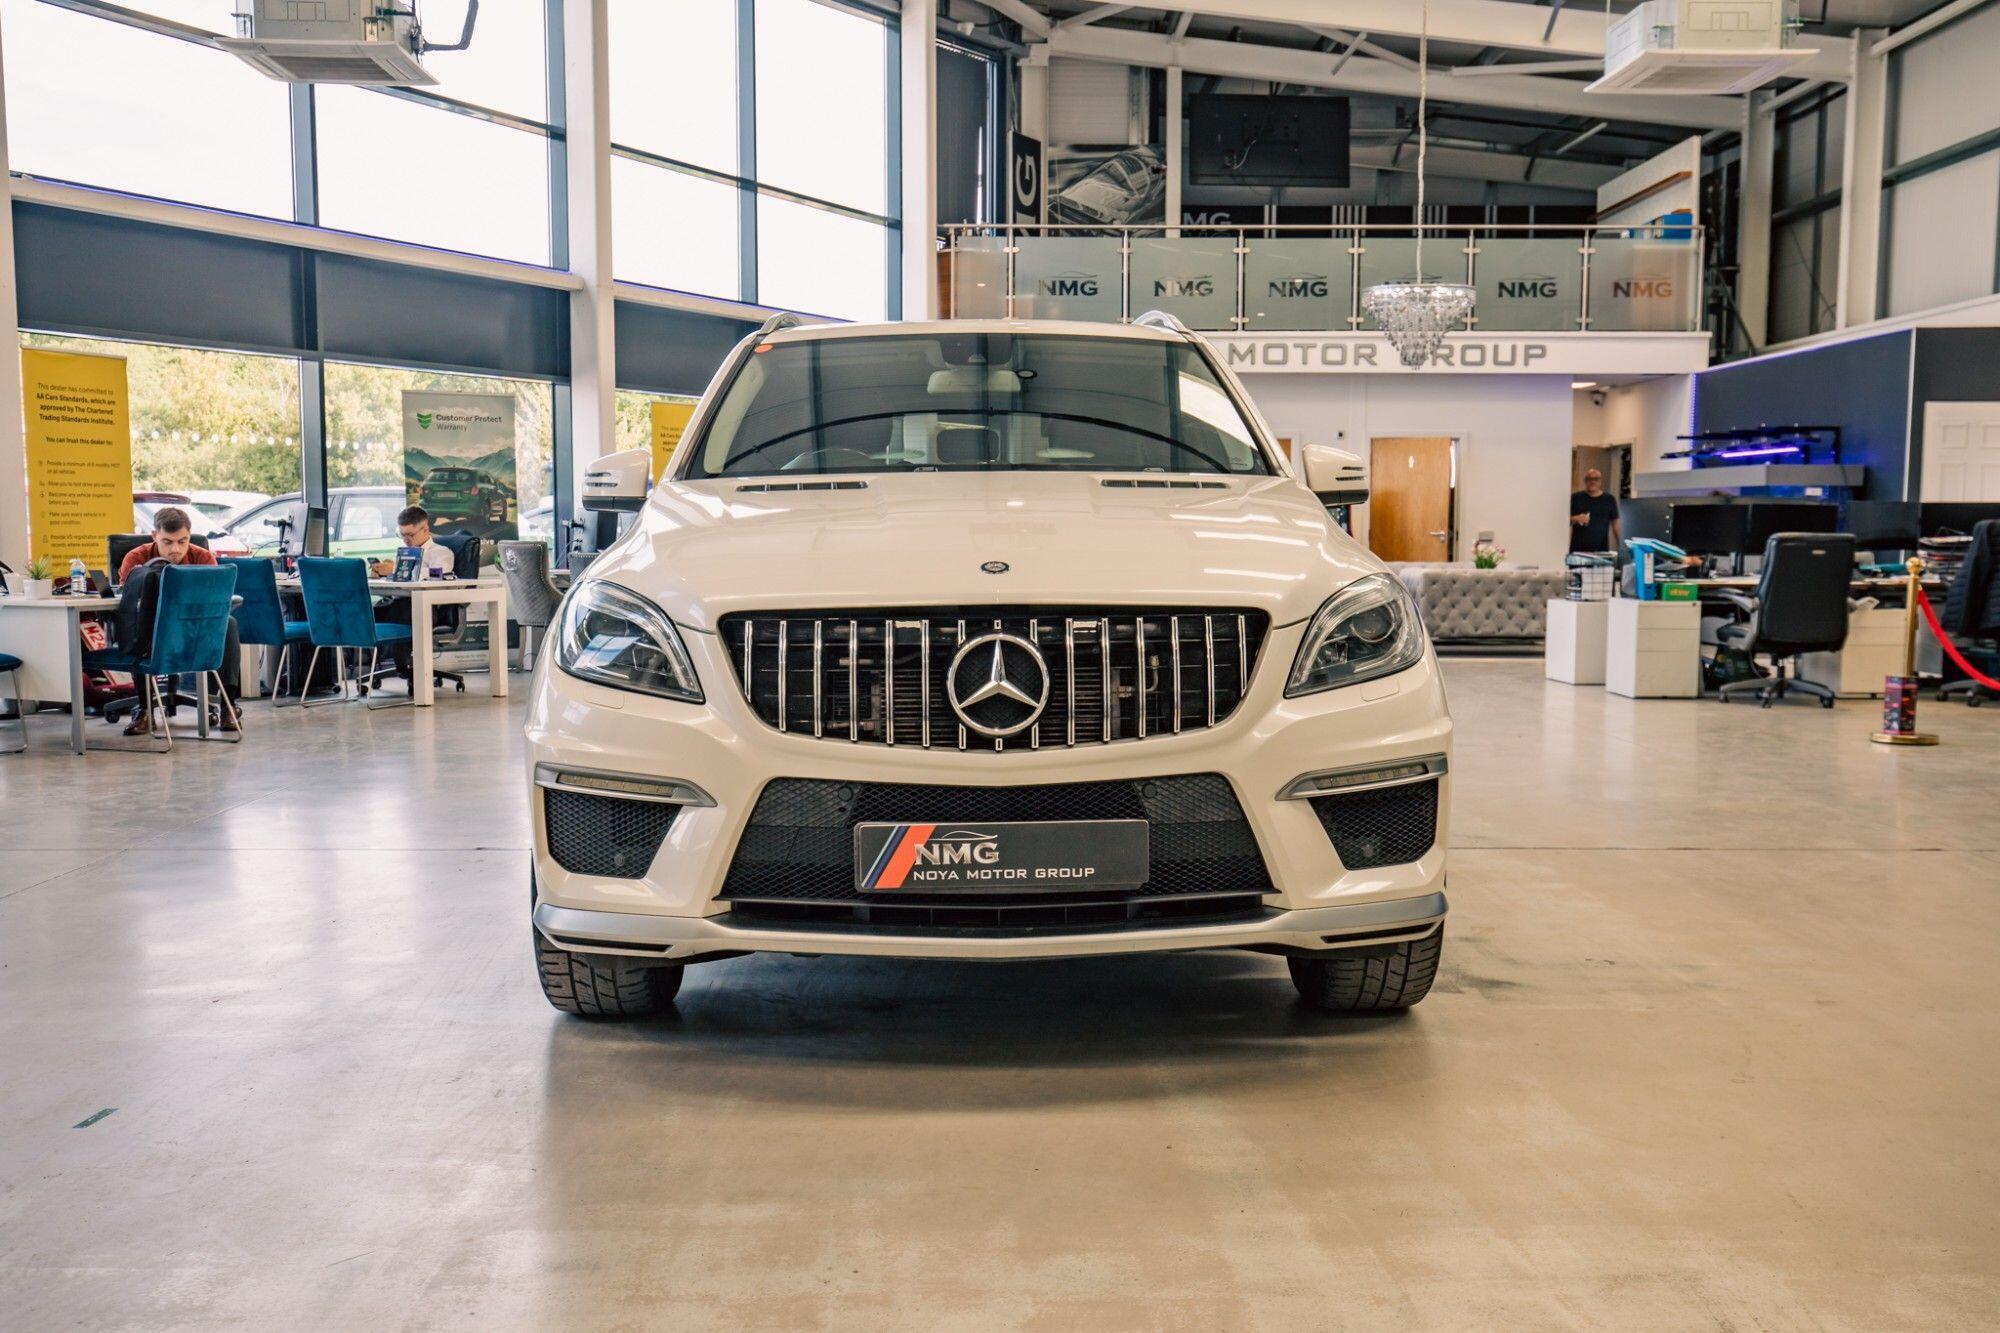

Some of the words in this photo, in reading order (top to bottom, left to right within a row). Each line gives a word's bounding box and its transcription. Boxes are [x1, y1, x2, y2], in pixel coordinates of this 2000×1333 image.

[1038, 280, 1098, 296] NMG
[1154, 280, 1213, 297] NMG
[1268, 281, 1328, 297] NMG
[1498, 282, 1557, 298] NMG
[1613, 282, 1672, 298] NMG
[1228, 343, 1377, 366] MOTOR
[40, 414, 60, 422] Trading
[436, 424, 467, 432] Warranty
[914, 842, 1000, 866] NMG
[913, 870, 958, 881] NOYA
[966, 869, 1028, 880] MOTOR
[1035, 867, 1095, 878] GROUP
